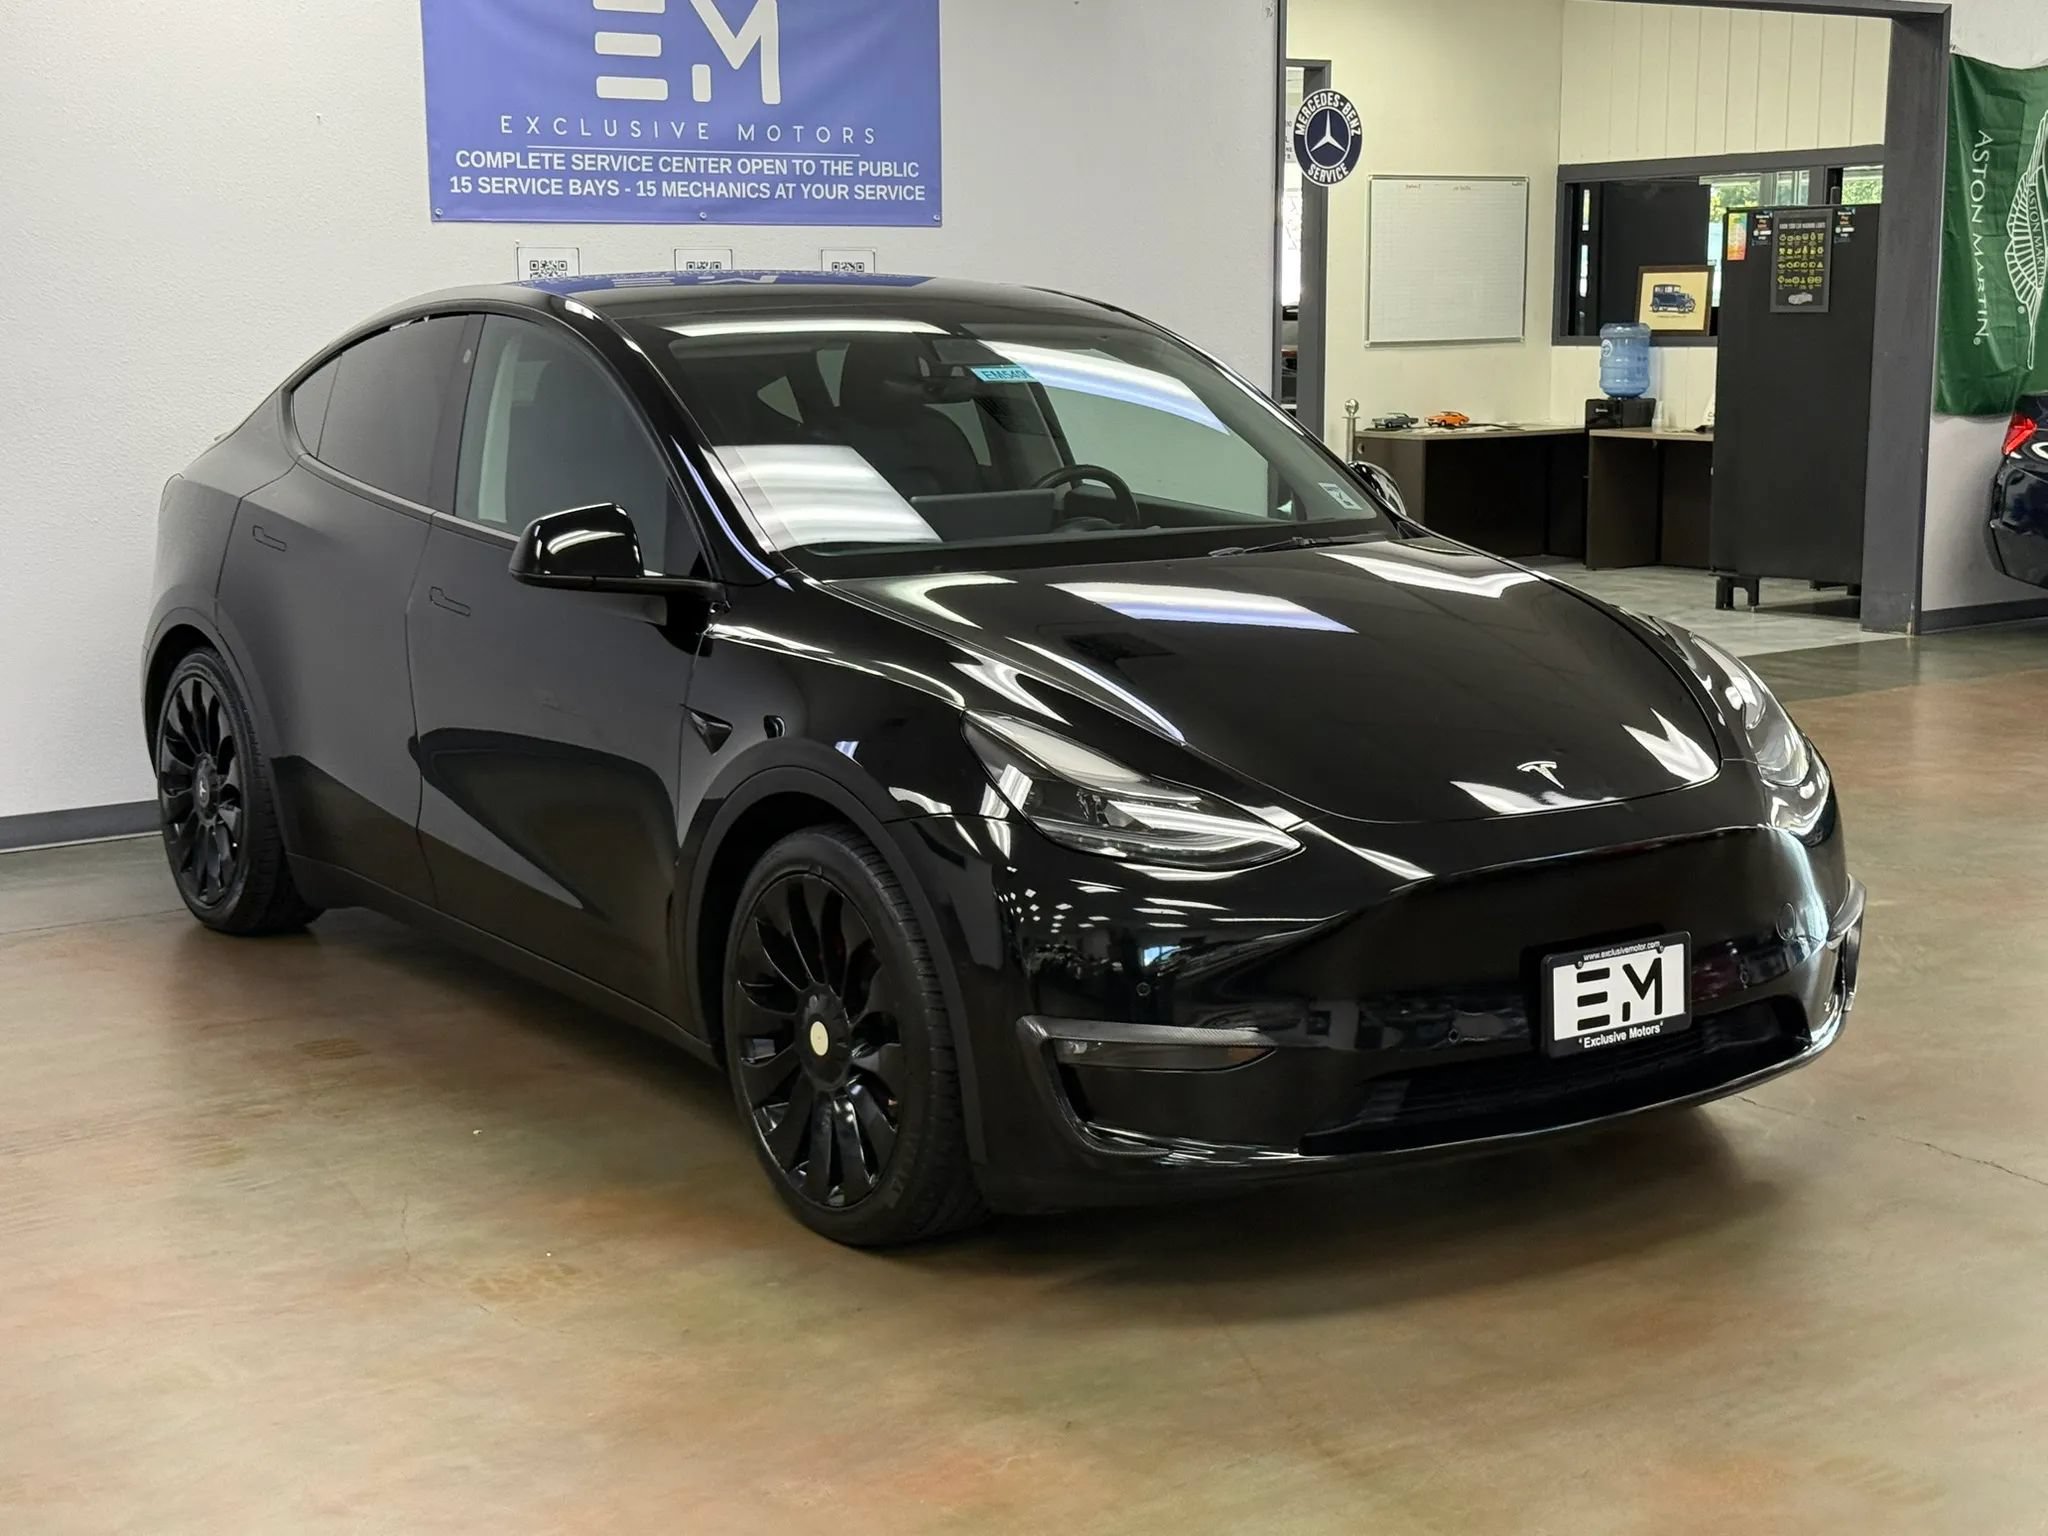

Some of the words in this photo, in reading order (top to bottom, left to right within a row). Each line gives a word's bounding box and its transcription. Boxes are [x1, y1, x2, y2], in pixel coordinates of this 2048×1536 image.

[593, 0, 781, 104] EM
[501, 116, 708, 139] EXCLUSIVE
[738, 124, 875, 144] MOTORS
[456, 151, 565, 169] COMPLETE
[572, 154, 653, 171] SERVICE
[659, 156, 732, 174] CENTER
[738, 159, 787, 174] OPEN
[792, 160, 815, 175] TO
[820, 160, 853, 176] THE
[859, 161, 918, 177] PUBLIC
[1308, 163, 1349, 183] SERVICE
[1970, 129, 1993, 223] ASTON
[450, 176, 472, 193] 15
[478, 177, 563, 194] SERVICE
[569, 179, 619, 196] BAYS
[637, 181, 656, 196] 15
[662, 181, 770, 198] MECHANICS
[775, 183, 796, 198] AT
[801, 184, 849, 199] YOUR
[854, 185, 925, 200] SERVICE
[2028, 186, 2041, 232] ASTON
[2033, 234, 2046, 289] MARTIN
[1971, 233, 1990, 338] MARTIN
[1583, 941, 1660, 961] www.exclusivemotor.com
[1577, 957, 1662, 1031] EM
